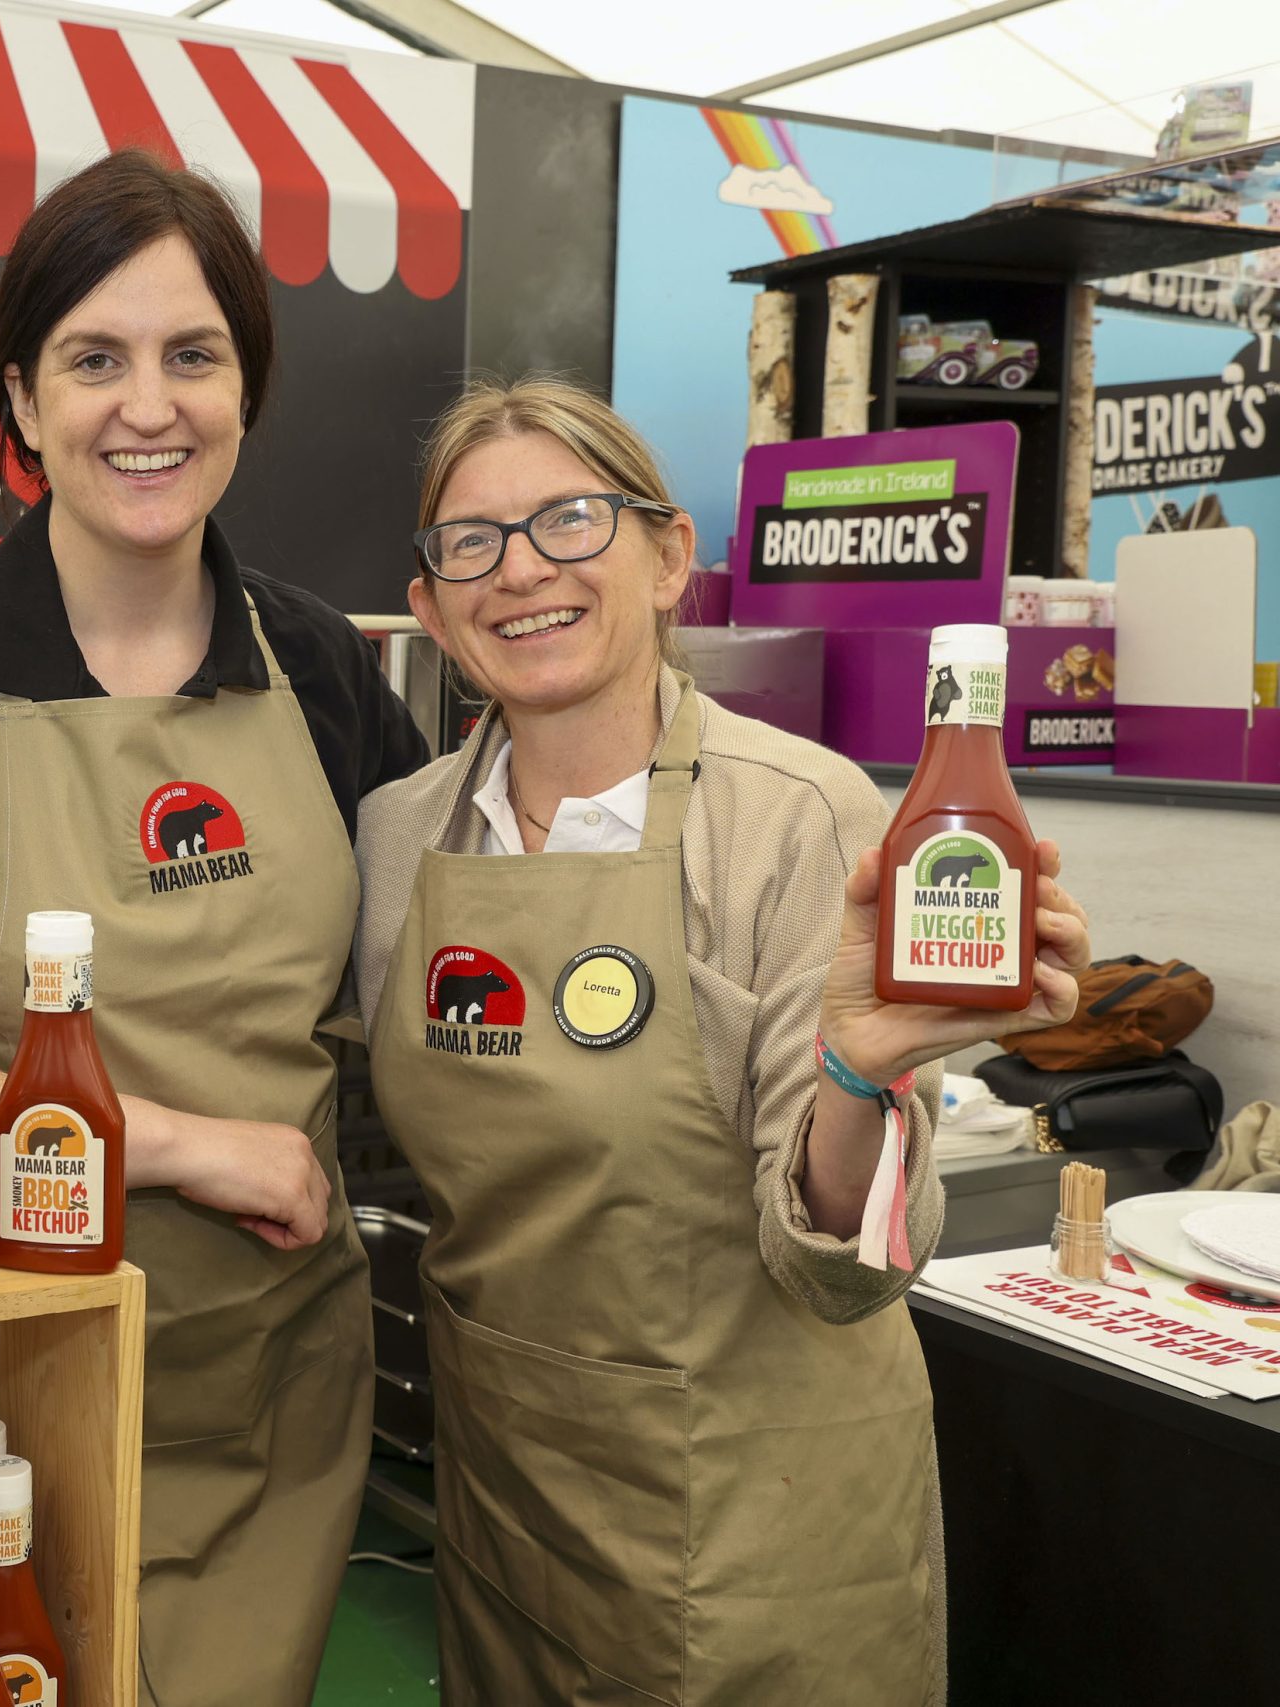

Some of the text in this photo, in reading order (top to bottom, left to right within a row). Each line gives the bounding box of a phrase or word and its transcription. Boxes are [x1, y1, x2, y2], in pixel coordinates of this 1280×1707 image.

[1155, 455, 1225, 483] CAKERY
[788, 470, 949, 498] Handmade in Ireland
[762, 506, 972, 567] BRODERICK'S
[969, 686, 1000, 701] SHAKE
[968, 701, 999, 716] SHAKE
[1029, 716, 1115, 745] BRODERICK
[151, 798, 164, 815] FOOD
[161, 791, 173, 802] FOR
[171, 787, 187, 797] GOOD
[149, 851, 253, 894] MAMA BEAR
[914, 890, 1000, 909] MAMA BEAR
[455, 951, 474, 962] GOOD
[574, 947, 636, 966] BALLYMALOE FOODS
[910, 940, 1005, 969] KETCHUP
[33, 975, 62, 988] SHAKE
[583, 980, 621, 997] Loretta
[33, 990, 62, 1003] SHAKE
[554, 1005, 560, 1016] AN
[557, 1016, 570, 1033] IRISH
[568, 1031, 592, 1045] FAMILY
[592, 1037, 611, 1045] FOOD
[612, 1012, 640, 1040] COMPANY
[426, 1024, 523, 1056] MAMA BEAR
[15, 1157, 85, 1175] MAMA BEAR
[13, 1176, 22, 1207] SMOKEY
[23, 1177, 70, 1211] BBQ
[12, 1207, 89, 1234] KETCHUP
[995, 1272, 1074, 1295] BUY
[1065, 1292, 1118, 1311] TO
[983, 1282, 1243, 1367] MEAL PLANNER
